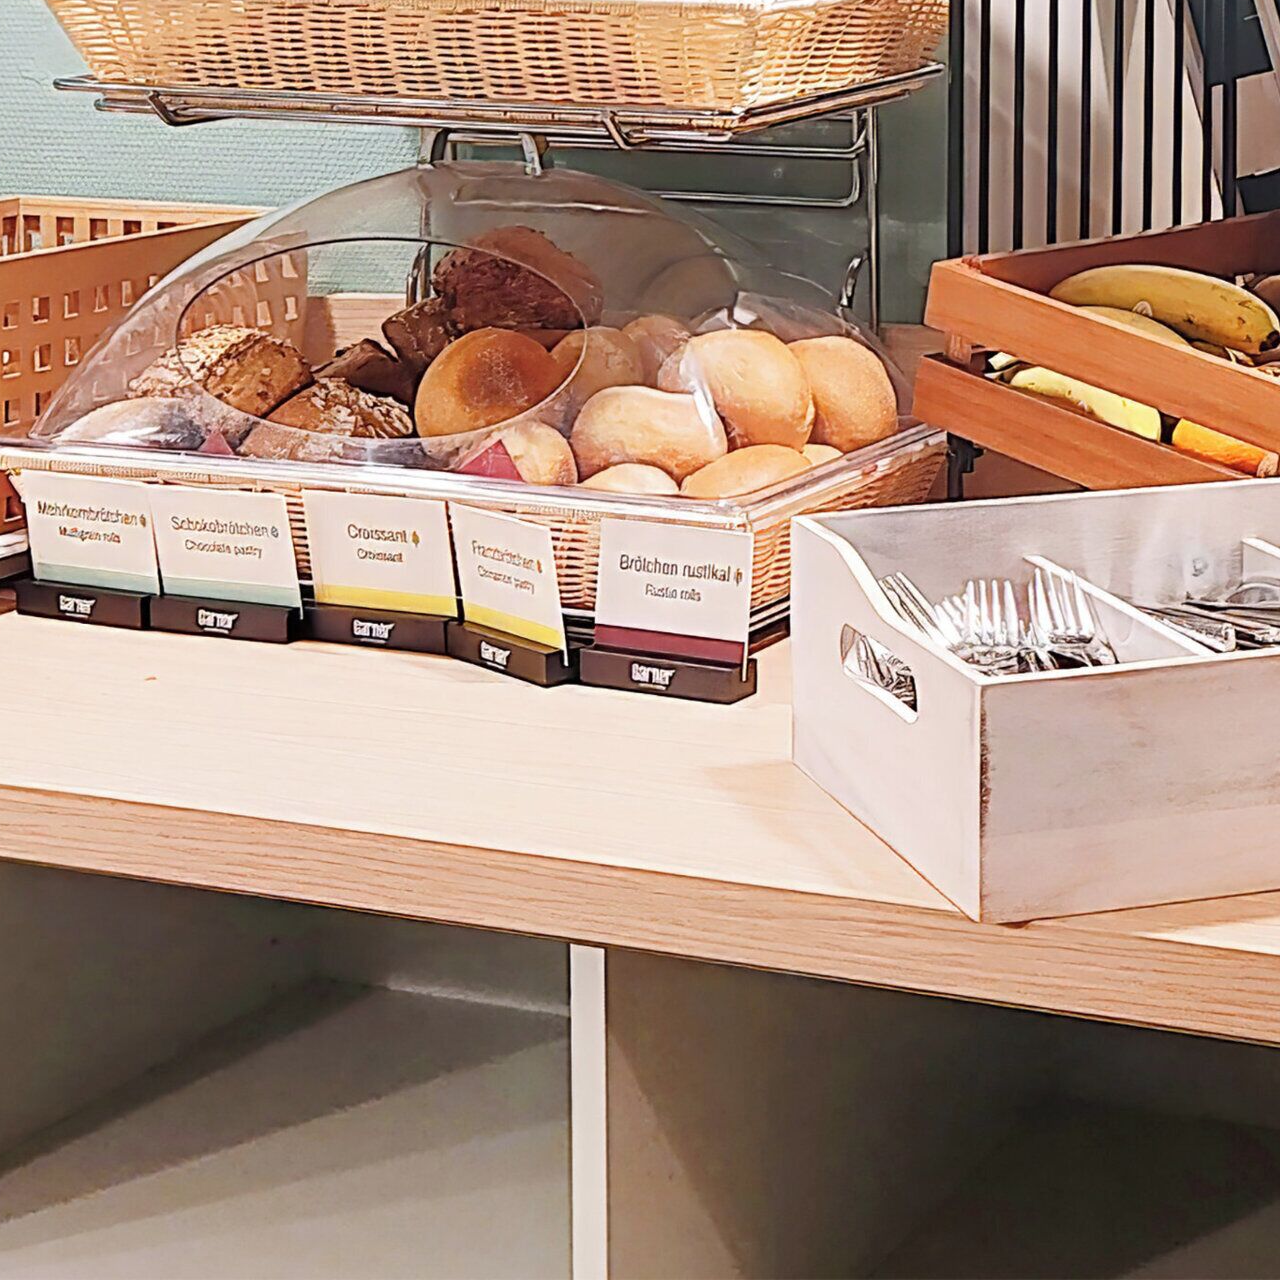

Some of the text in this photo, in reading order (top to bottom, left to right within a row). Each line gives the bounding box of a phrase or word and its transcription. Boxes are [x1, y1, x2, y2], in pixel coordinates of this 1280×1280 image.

[347, 524, 408, 543] Croissant
[619, 554, 731, 582] Brötchen rustikal
